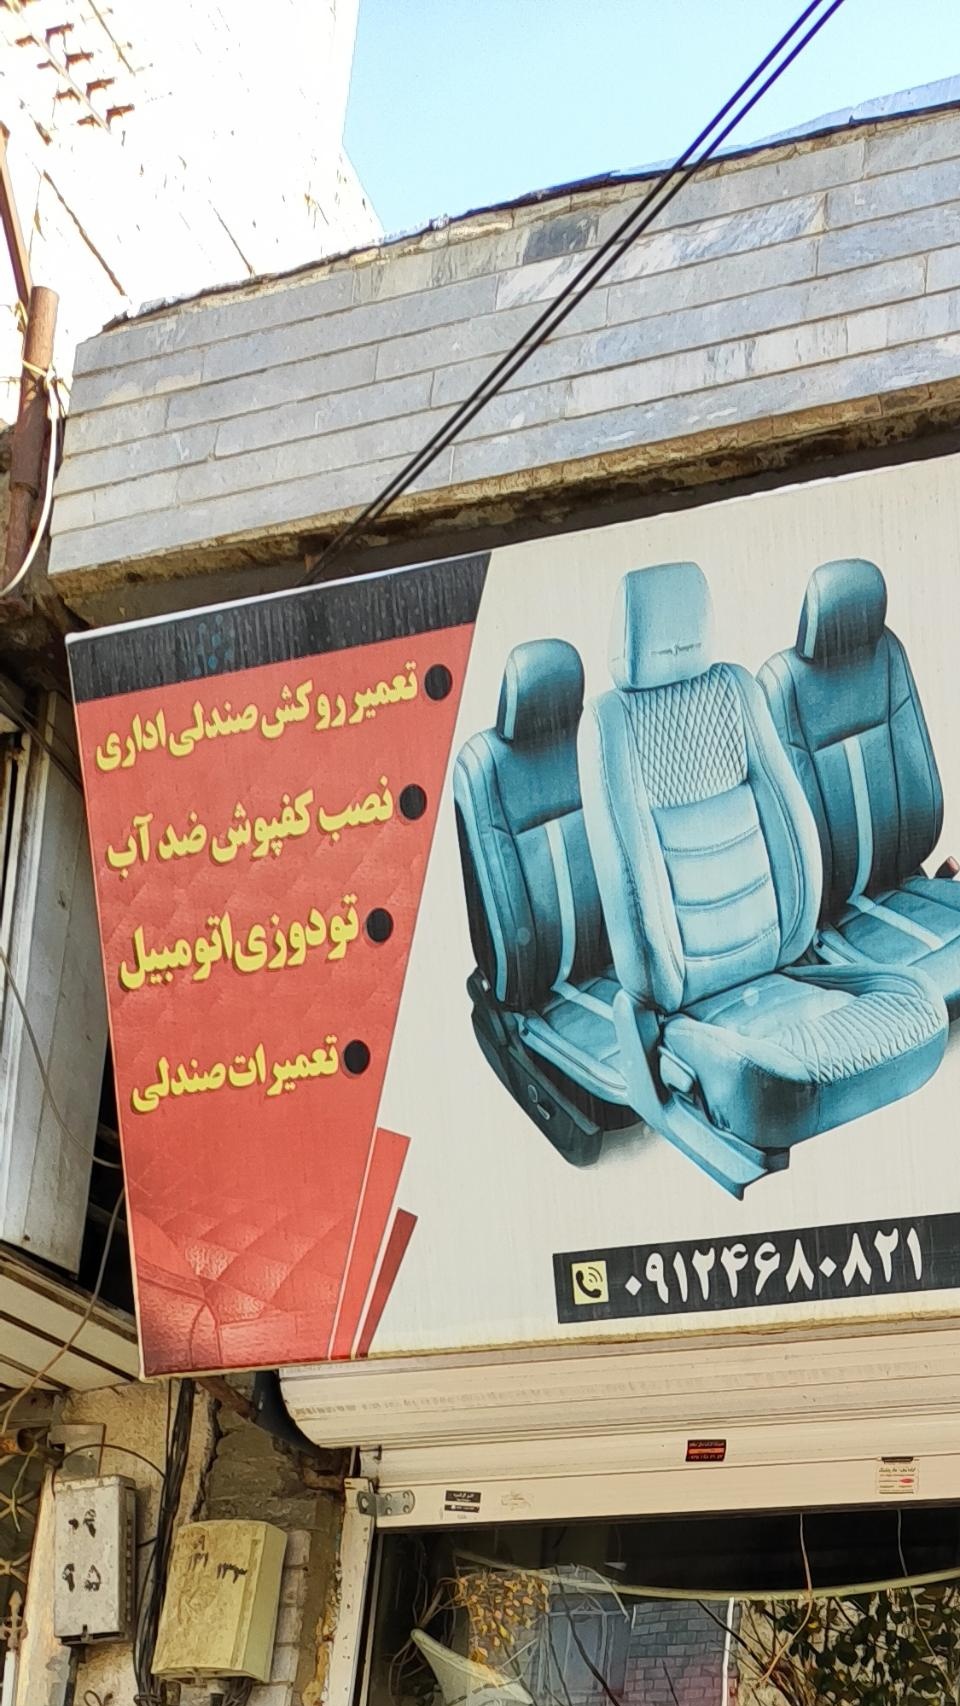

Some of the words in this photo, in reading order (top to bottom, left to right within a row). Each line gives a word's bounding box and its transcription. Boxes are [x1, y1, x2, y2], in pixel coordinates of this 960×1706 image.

[252, 680, 347, 740] روکش
[348, 660, 419, 725] تعمیر
[95, 708, 167, 771] اداری
[167, 700, 259, 758] صندلی
[157, 811, 207, 860] ضد
[210, 788, 315, 863] کفپوش
[318, 775, 394, 842] نصب
[106, 813, 154, 879] آب
[118, 915, 233, 991] اتومبیل
[232, 893, 360, 974] تودوزی
[131, 1057, 226, 1113] صندلی
[226, 1034, 339, 1096] تعمیرات
[624, 1226, 923, 1305] ۰۹۱۲۴۶۸۰۸۲۱
